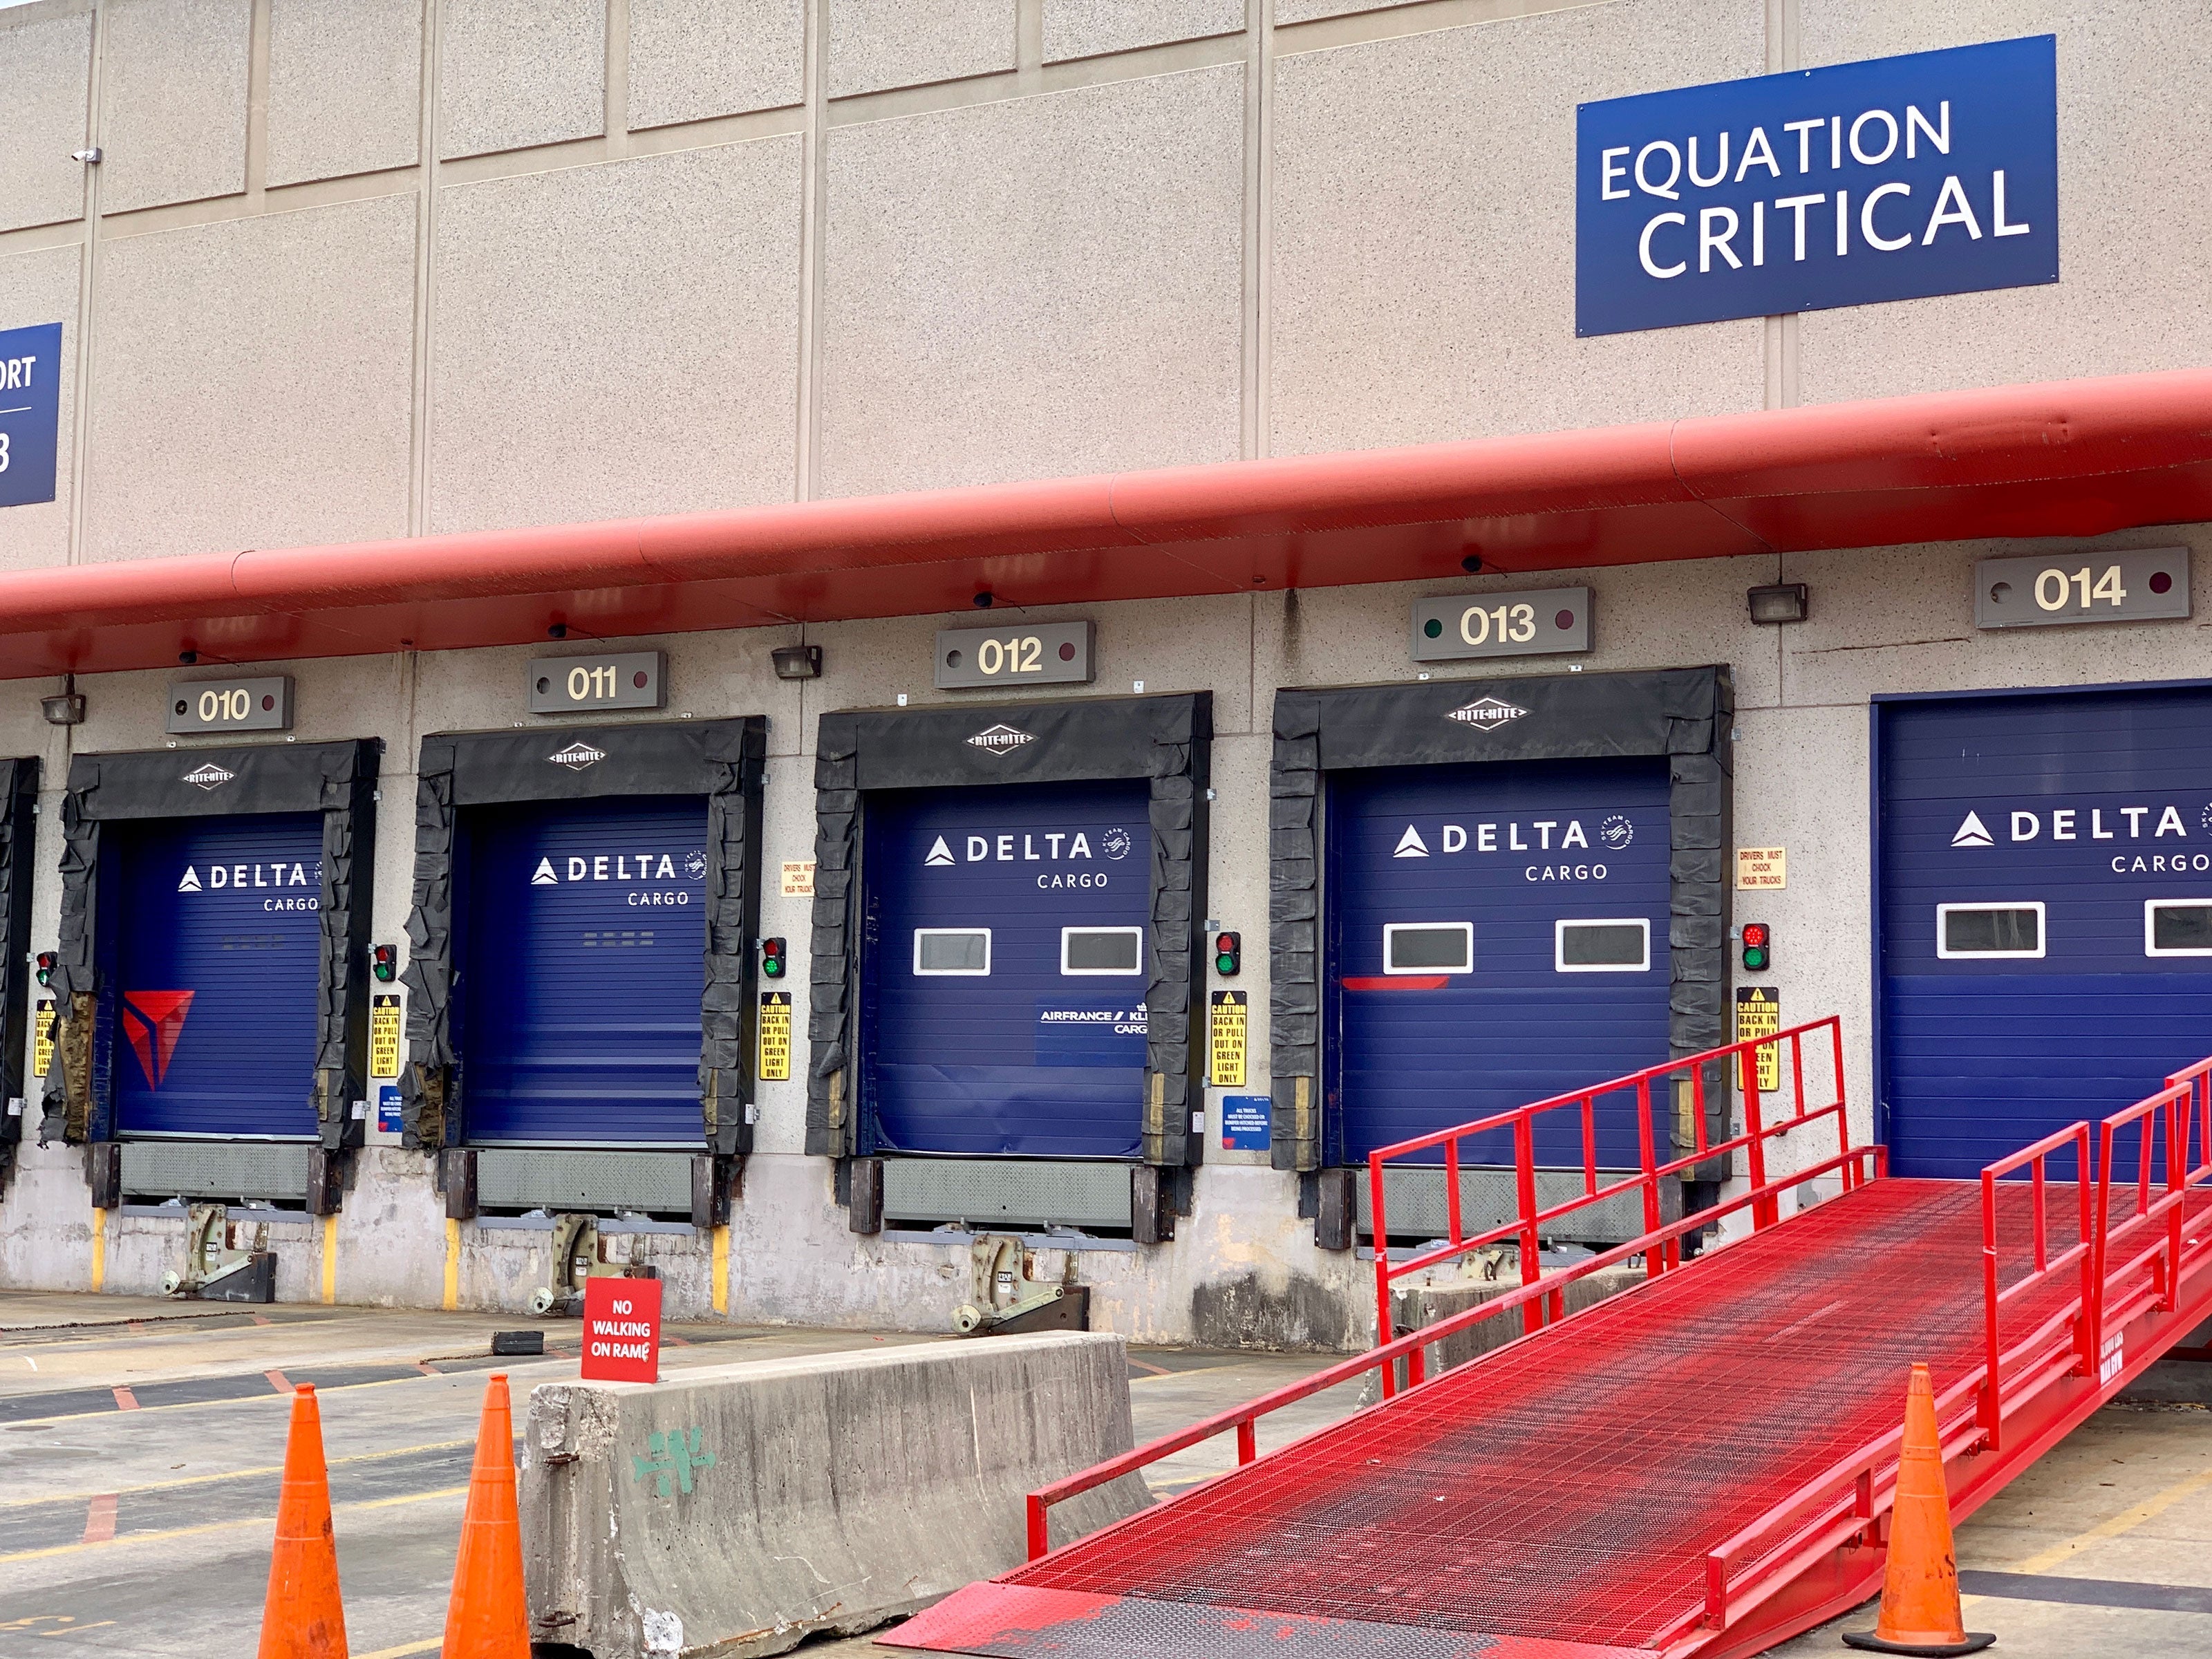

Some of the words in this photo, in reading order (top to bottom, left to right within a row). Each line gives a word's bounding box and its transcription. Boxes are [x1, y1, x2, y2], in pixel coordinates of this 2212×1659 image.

[1600, 100, 1951, 201] EQUATION
[1638, 169, 2031, 280] CRITICAL
[2034, 565, 2126, 611] 014
[1460, 603, 1536, 645] 013
[978, 636, 1042, 675] 012
[568, 666, 616, 700] 011
[198, 688, 250, 722] 010
[1600, 815, 1624, 841] SKYTEAM
[2011, 806, 2187, 841] DELTA
[1442, 820, 1588, 853] DELTA
[966, 832, 1092, 861] DELTA
[1740, 851, 1763, 860] DRIVERS
[1768, 851, 1783, 859] MUST
[568, 854, 676, 881] DELTA
[1752, 863, 1771, 872] CHOCK
[2112, 854, 2209, 873] CARGO
[210, 863, 307, 888] DELTA
[1525, 863, 1608, 881] CARGO
[1037, 873, 1107, 889] CARGO
[1742, 877, 1757, 885] YOUR
[1759, 876, 1781, 885] TRUCKS
[263, 898, 318, 911] CARGO
[628, 892, 688, 906] CARGO
[373, 1006, 400, 1015] CAUTION
[761, 1004, 790, 1013] CAUTION
[1212, 1004, 1246, 1014] CAUTION
[1737, 1002, 1778, 1012] CAUTION
[1040, 1011, 1112, 1021] AIRFRANCE
[1213, 1017, 1233, 1025] BACK
[1237, 1017, 1244, 1025] IN
[1739, 1015, 1763, 1024] BACK
[1768, 1015, 1777, 1024] IN
[762, 1027, 771, 1035] OR
[774, 1027, 788, 1035] PULL
[1114, 1024, 1147, 1034] CARG
[1213, 1029, 1223, 1037] OR
[1226, 1028, 1244, 1037] PULL
[1740, 1028, 1751, 1037] OR
[763, 1037, 775, 1045] OUT
[1215, 1040, 1229, 1049] OUT
[1232, 1040, 1242, 1048] ON
[1217, 1051, 1240, 1060] GREEN
[765, 1058, 784, 1067] LIGHT
[1217, 1062, 1239, 1071] LIGHT
[767, 1069, 782, 1077] ONLY
[1219, 1074, 1237, 1082] ONLY
[612, 1299, 632, 1315] NO
[592, 1320, 650, 1338] WALKING
[591, 1341, 610, 1357] ON
